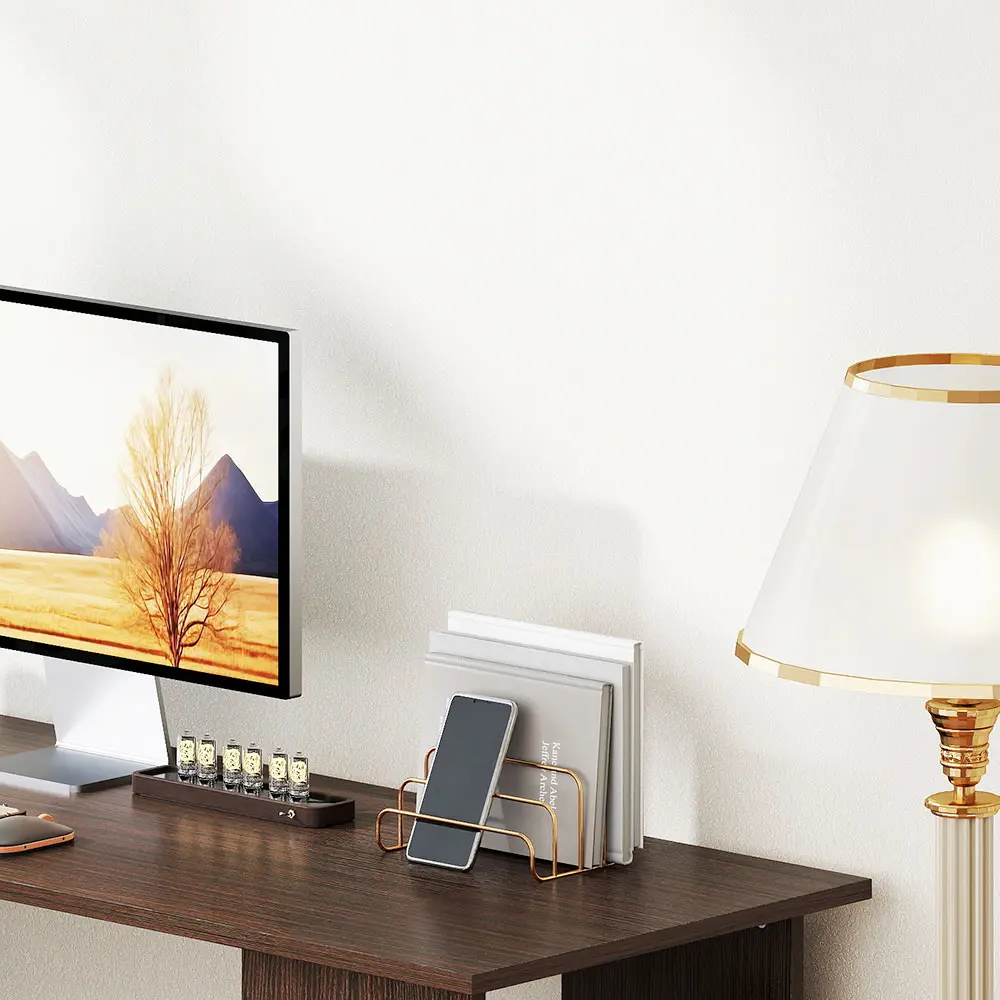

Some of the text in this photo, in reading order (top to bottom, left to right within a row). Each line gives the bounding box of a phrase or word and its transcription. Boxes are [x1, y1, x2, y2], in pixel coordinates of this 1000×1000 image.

[539, 741, 549, 802] Jeffre Arche
[551, 741, 560, 766] Kane
